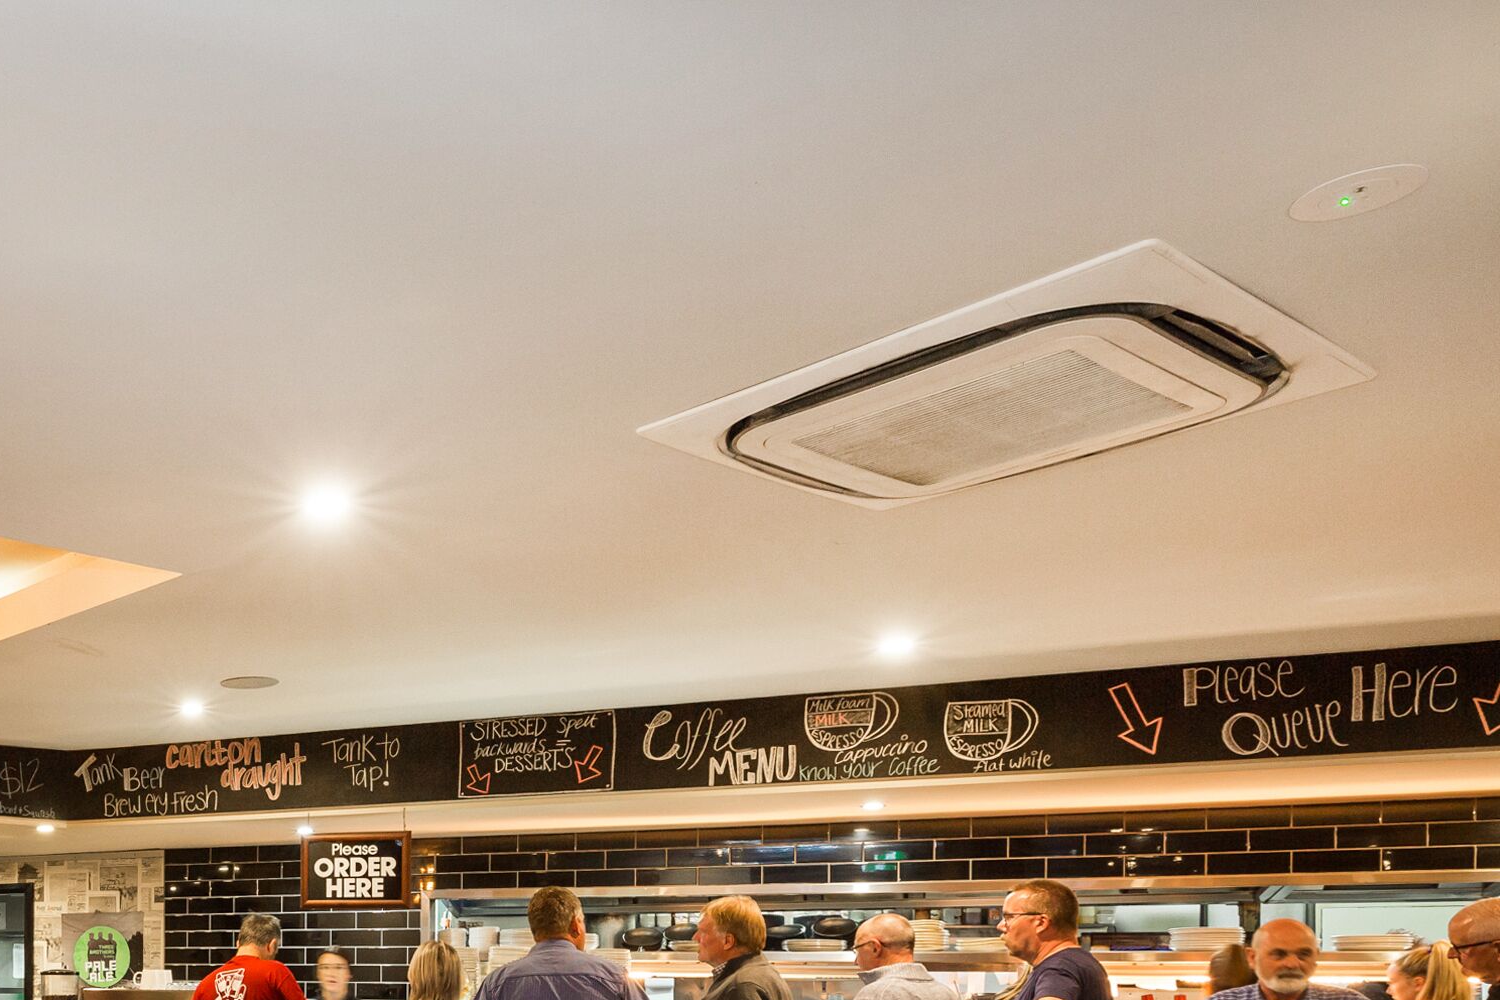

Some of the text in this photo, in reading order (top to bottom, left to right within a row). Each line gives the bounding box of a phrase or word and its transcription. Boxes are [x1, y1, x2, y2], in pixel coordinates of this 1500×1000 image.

[1183, 659, 1306, 706] Please
[836, 697, 871, 712] foam
[953, 703, 1006, 720] Steamed
[1221, 662, 1458, 757] Queue Here
[470, 717, 547, 741] STRESSED
[814, 713, 851, 726] MILK
[962, 718, 999, 733] MILK
[321, 732, 401, 764] Tank to
[474, 738, 547, 760] backwards
[643, 707, 750, 770] Coffee
[811, 727, 865, 749] ESPRESSO
[948, 736, 1003, 759] ESPRESSO
[165, 737, 262, 769] carlton
[494, 747, 576, 773] DESSERTS
[973, 750, 1052, 773] flat white
[74, 752, 166, 792] Tank Beer
[220, 742, 306, 801] draught
[343, 760, 390, 792] Tap!
[708, 744, 797, 786] MENU
[840, 760, 883, 780] your
[0, 758, 44, 799] $12
[171, 785, 218, 814] Fresh
[331, 842, 379, 856] Please
[313, 856, 397, 878] ORDER
[325, 877, 384, 898] HERE
[84, 960, 117, 972] PALE
[89, 972, 114, 983] ALE
